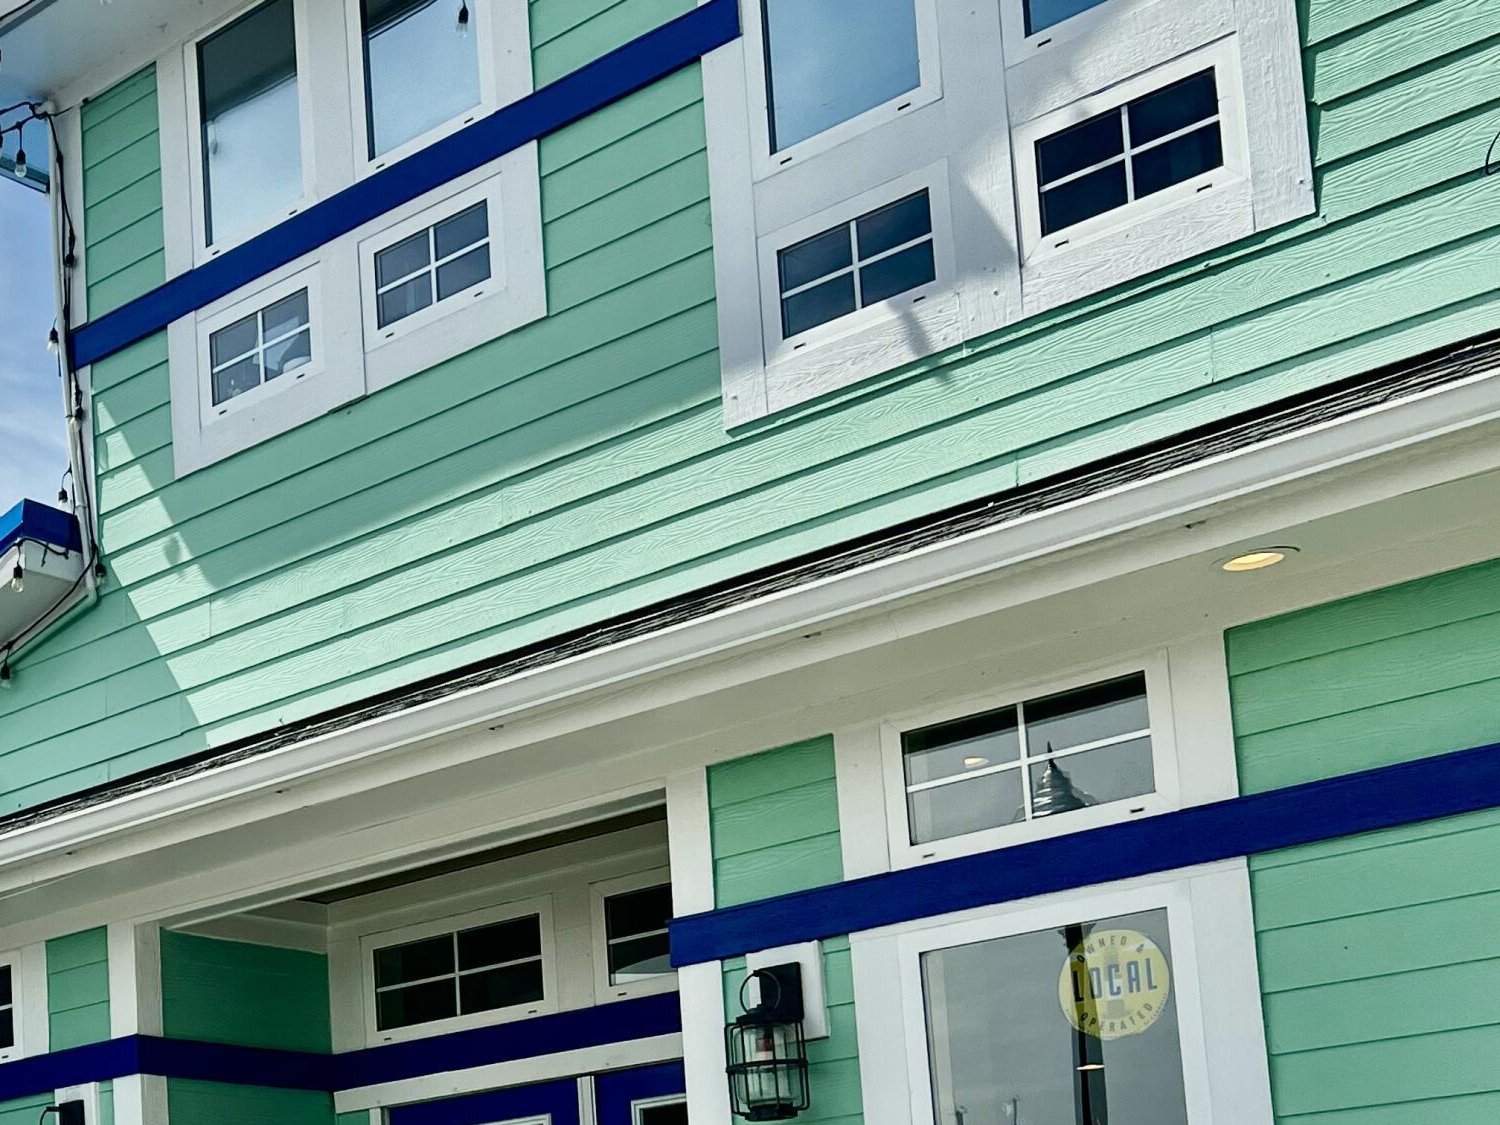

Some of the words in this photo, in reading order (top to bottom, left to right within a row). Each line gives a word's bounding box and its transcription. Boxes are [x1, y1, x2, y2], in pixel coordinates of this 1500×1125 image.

[1076, 935, 1127, 963] OWNED
[1136, 943, 1145, 953] &
[1072, 958, 1158, 1003] LOCAL
[1080, 1002, 1153, 1032] OPERATED
